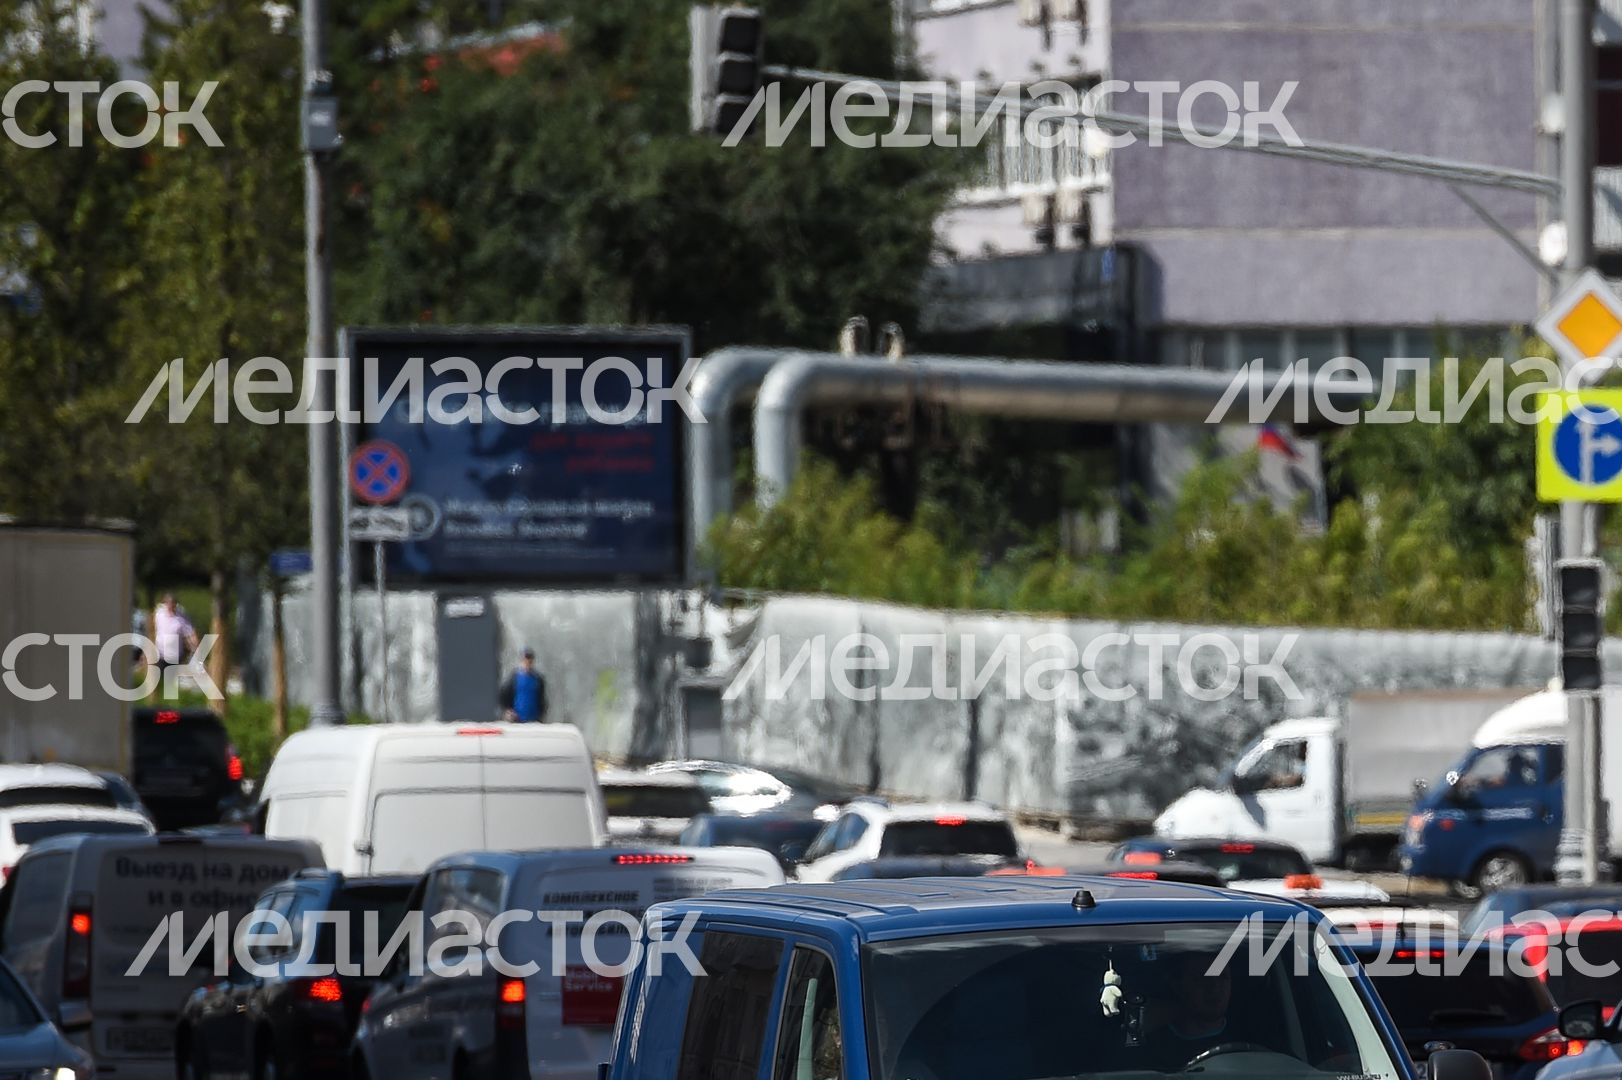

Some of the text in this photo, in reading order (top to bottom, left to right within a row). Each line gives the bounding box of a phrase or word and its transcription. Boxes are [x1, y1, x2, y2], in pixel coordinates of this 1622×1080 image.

[116, 857, 289, 883] Выезд на дом
